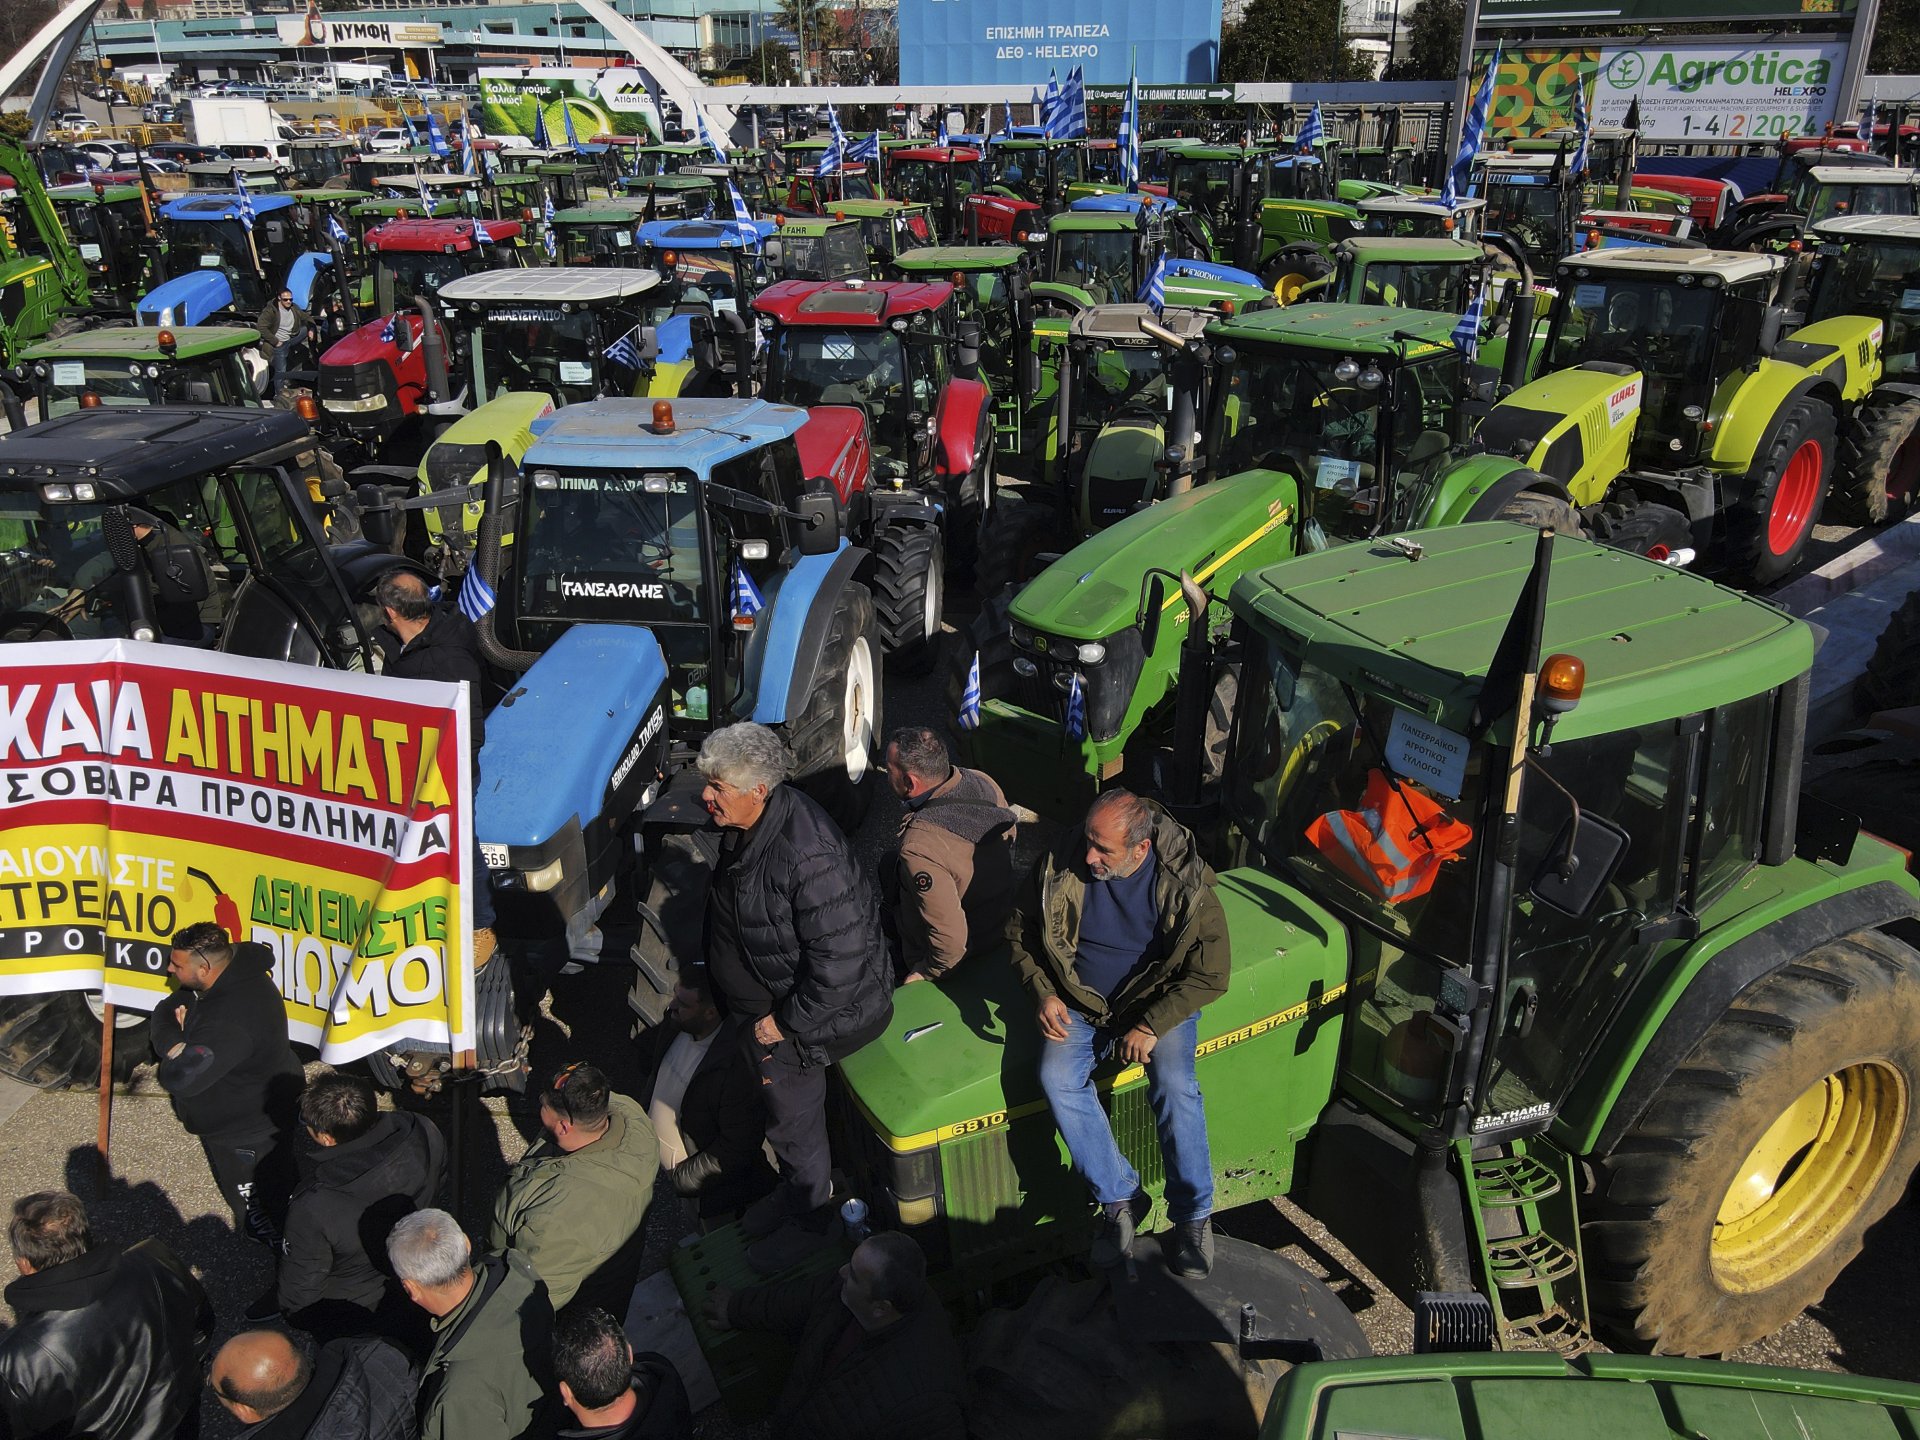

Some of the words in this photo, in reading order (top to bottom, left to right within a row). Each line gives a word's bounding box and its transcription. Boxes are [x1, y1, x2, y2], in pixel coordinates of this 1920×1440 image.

[332, 23, 391, 43] ΝΥΜΦΗ
[986, 26, 1044, 40] ΕΠΙΣΗΜΗ
[1048, 24, 1109, 38] ΤΡΑΠΕΖΑ
[996, 46, 1024, 59] ΔΕΘ
[1035, 45, 1098, 58] HELEXPO
[1647, 52, 1831, 93] Agrotica
[485, 83, 552, 96] Καλλιεργούμε
[486, 94, 522, 106] αλλιώς!
[1177, 89, 1207, 100] ΒΕΛΛΙΔΗΣ
[1774, 87, 1826, 96] HELEXPO
[1598, 118, 1619, 128] Keep
[786, 227, 807, 235] FAHR
[1610, 383, 1636, 407] CLAAS
[638, 704, 663, 747] TM150
[164, 688, 451, 809] ΑΙΤΗΜΑΤΑ
[1405, 740, 1448, 765] ΑΓΡΟΤΙΚΟΣ
[1402, 753, 1442, 777] ΣΥΛΛΟΓΟΣ
[7, 765, 178, 808] ΣΟΒΑΡΑ
[201, 781, 447, 857] ΠΡΟΒΛΗΜΑΑ
[250, 874, 315, 935] ΔΕΝ
[1194, 1028, 1250, 1057] DEERE
[952, 1112, 1004, 1135] 6810
[1475, 1120, 1505, 1130] SERVICE
